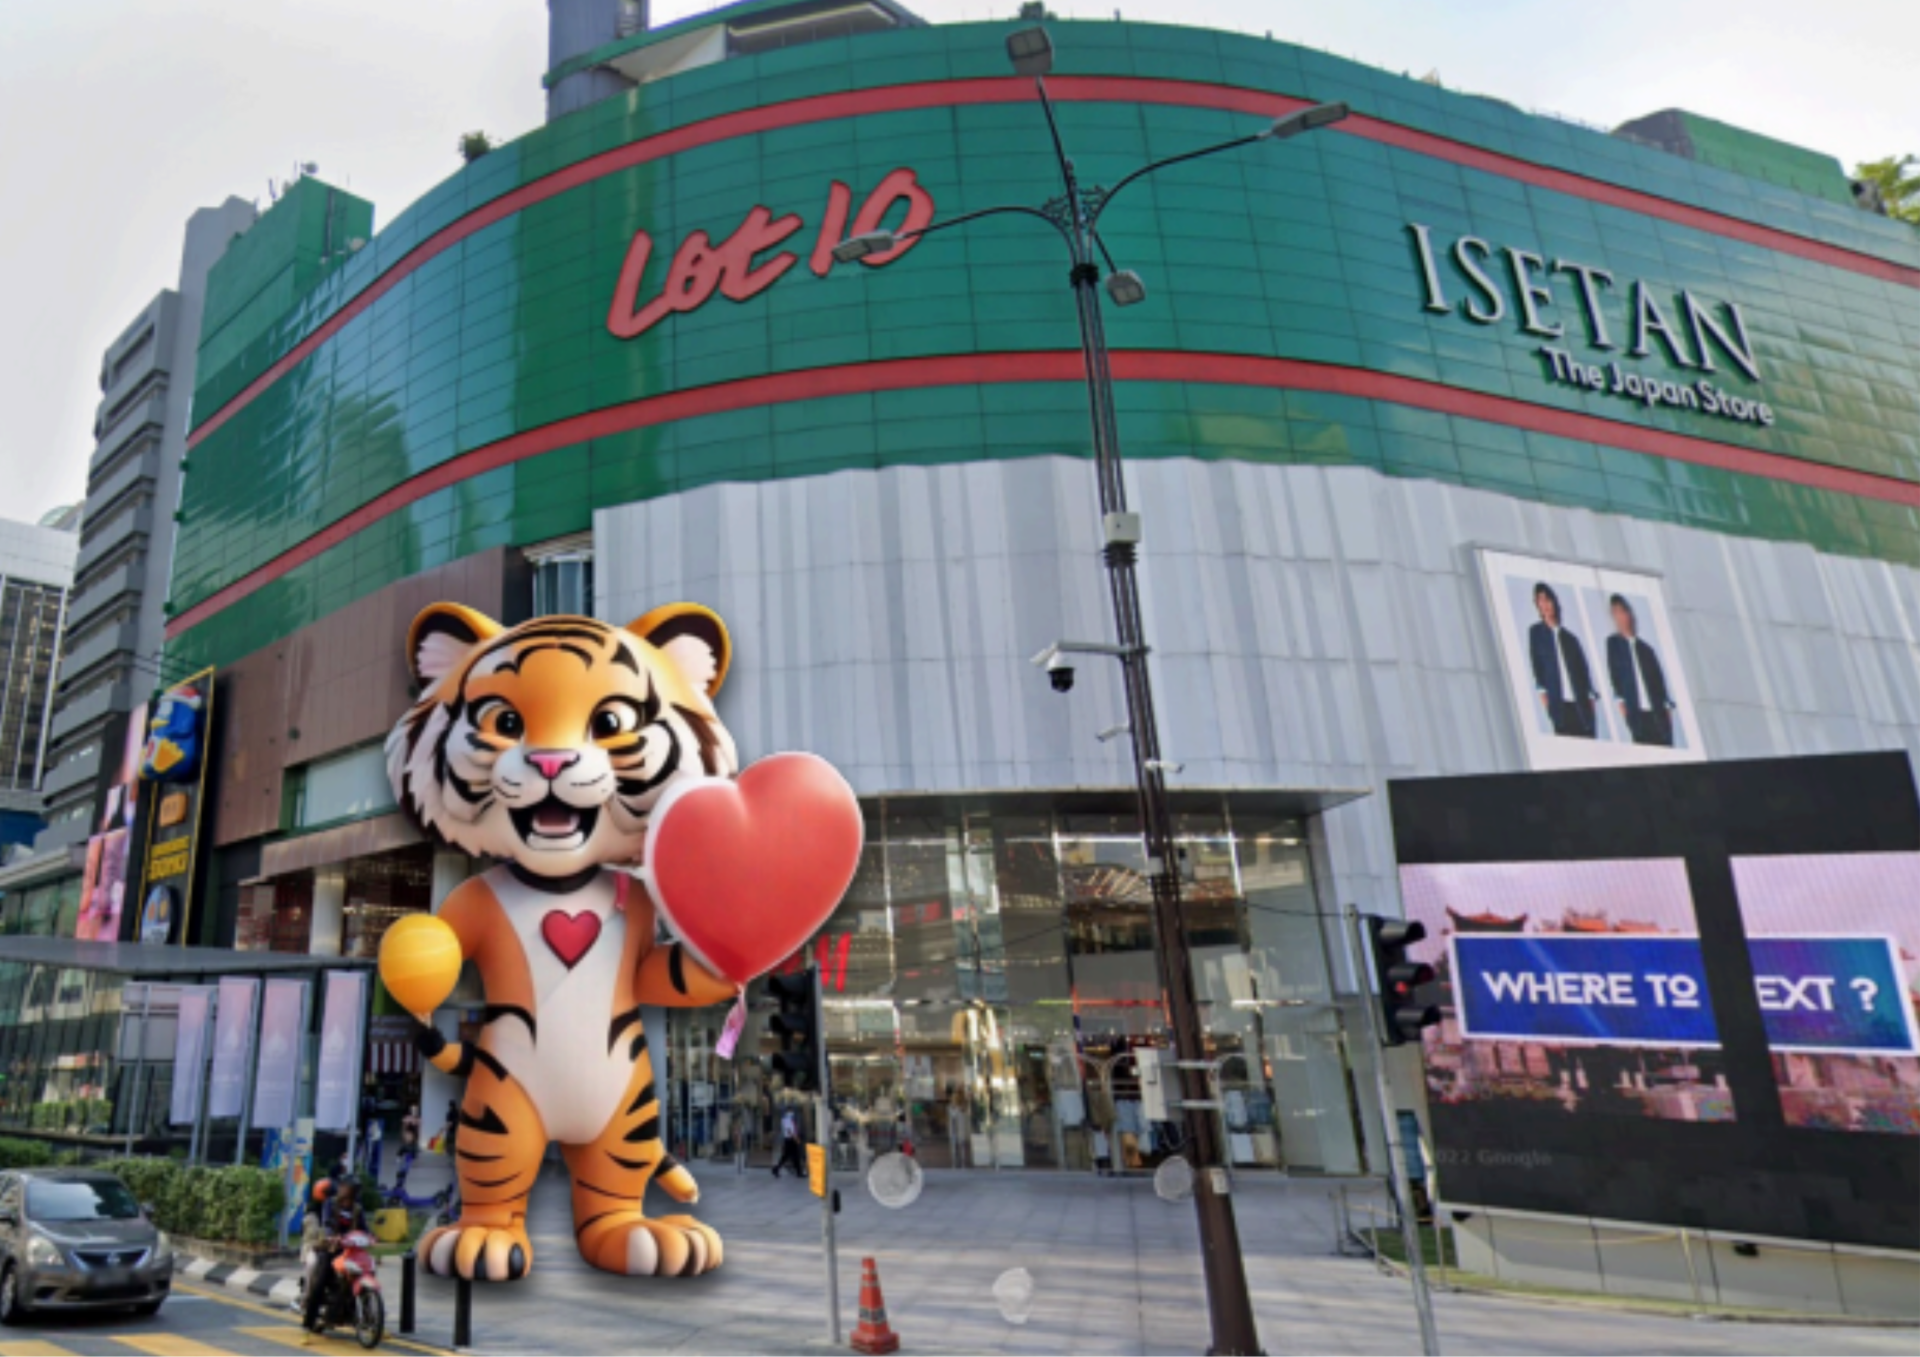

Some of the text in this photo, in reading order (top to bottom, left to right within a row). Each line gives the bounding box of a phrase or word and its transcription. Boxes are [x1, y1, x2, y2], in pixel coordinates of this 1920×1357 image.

[606, 166, 936, 339] Lot 10
[1407, 221, 1762, 383] ISETAN
[1540, 346, 1774, 425] The Japan Store
[1481, 971, 1879, 1012] WHERE TO EXT ?
